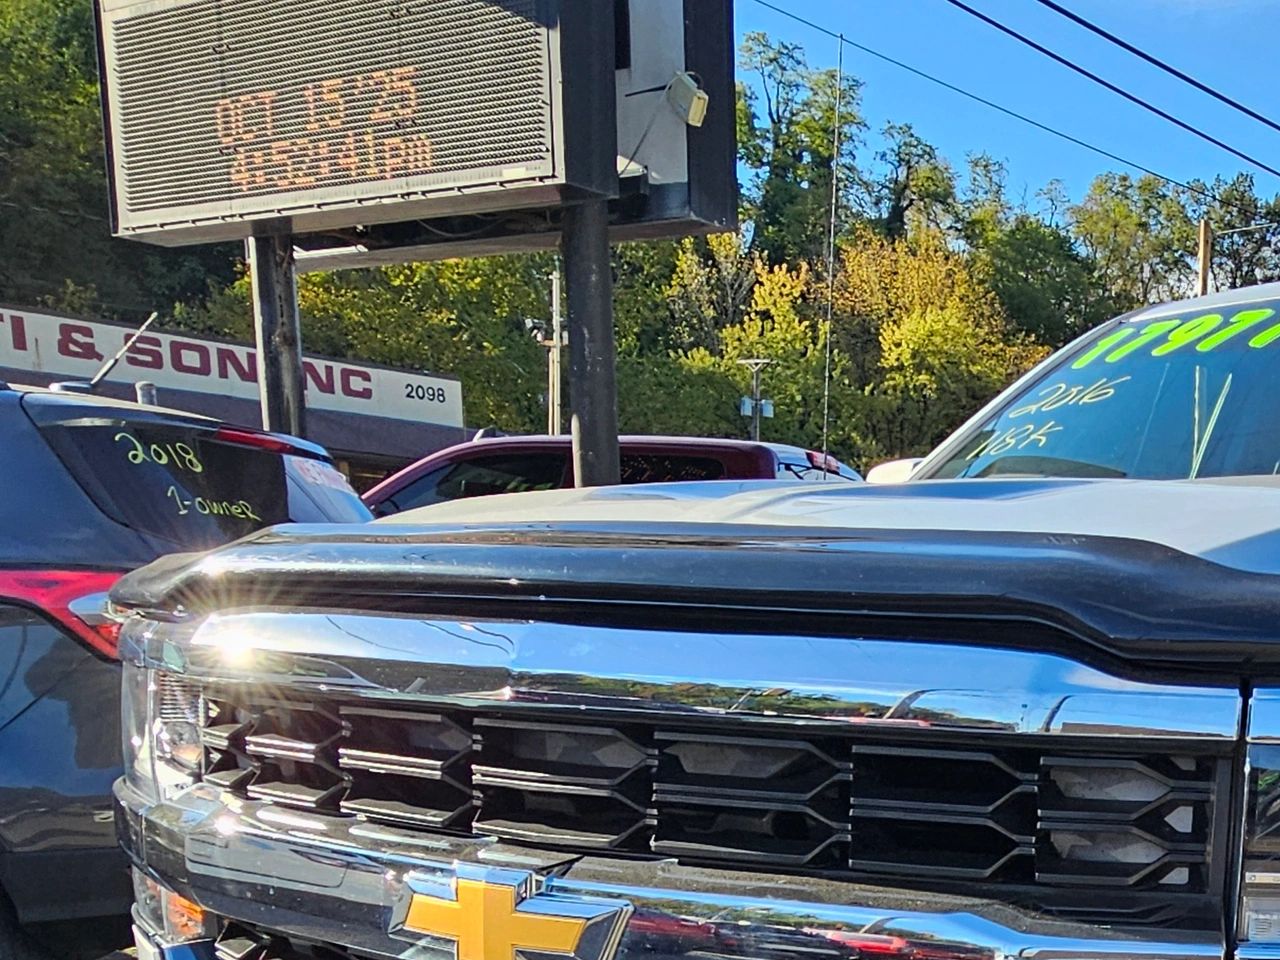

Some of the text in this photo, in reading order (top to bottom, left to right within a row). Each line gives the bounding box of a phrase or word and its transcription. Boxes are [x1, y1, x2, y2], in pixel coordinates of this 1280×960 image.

[216, 91, 276, 143] OCT
[304, 80, 345, 130] 15
[58, 323, 104, 362] &
[302, 360, 373, 400] NC
[405, 383, 446, 404] 2098
[1009, 375, 1132, 419] 2016
[115, 432, 203, 473] 2018
